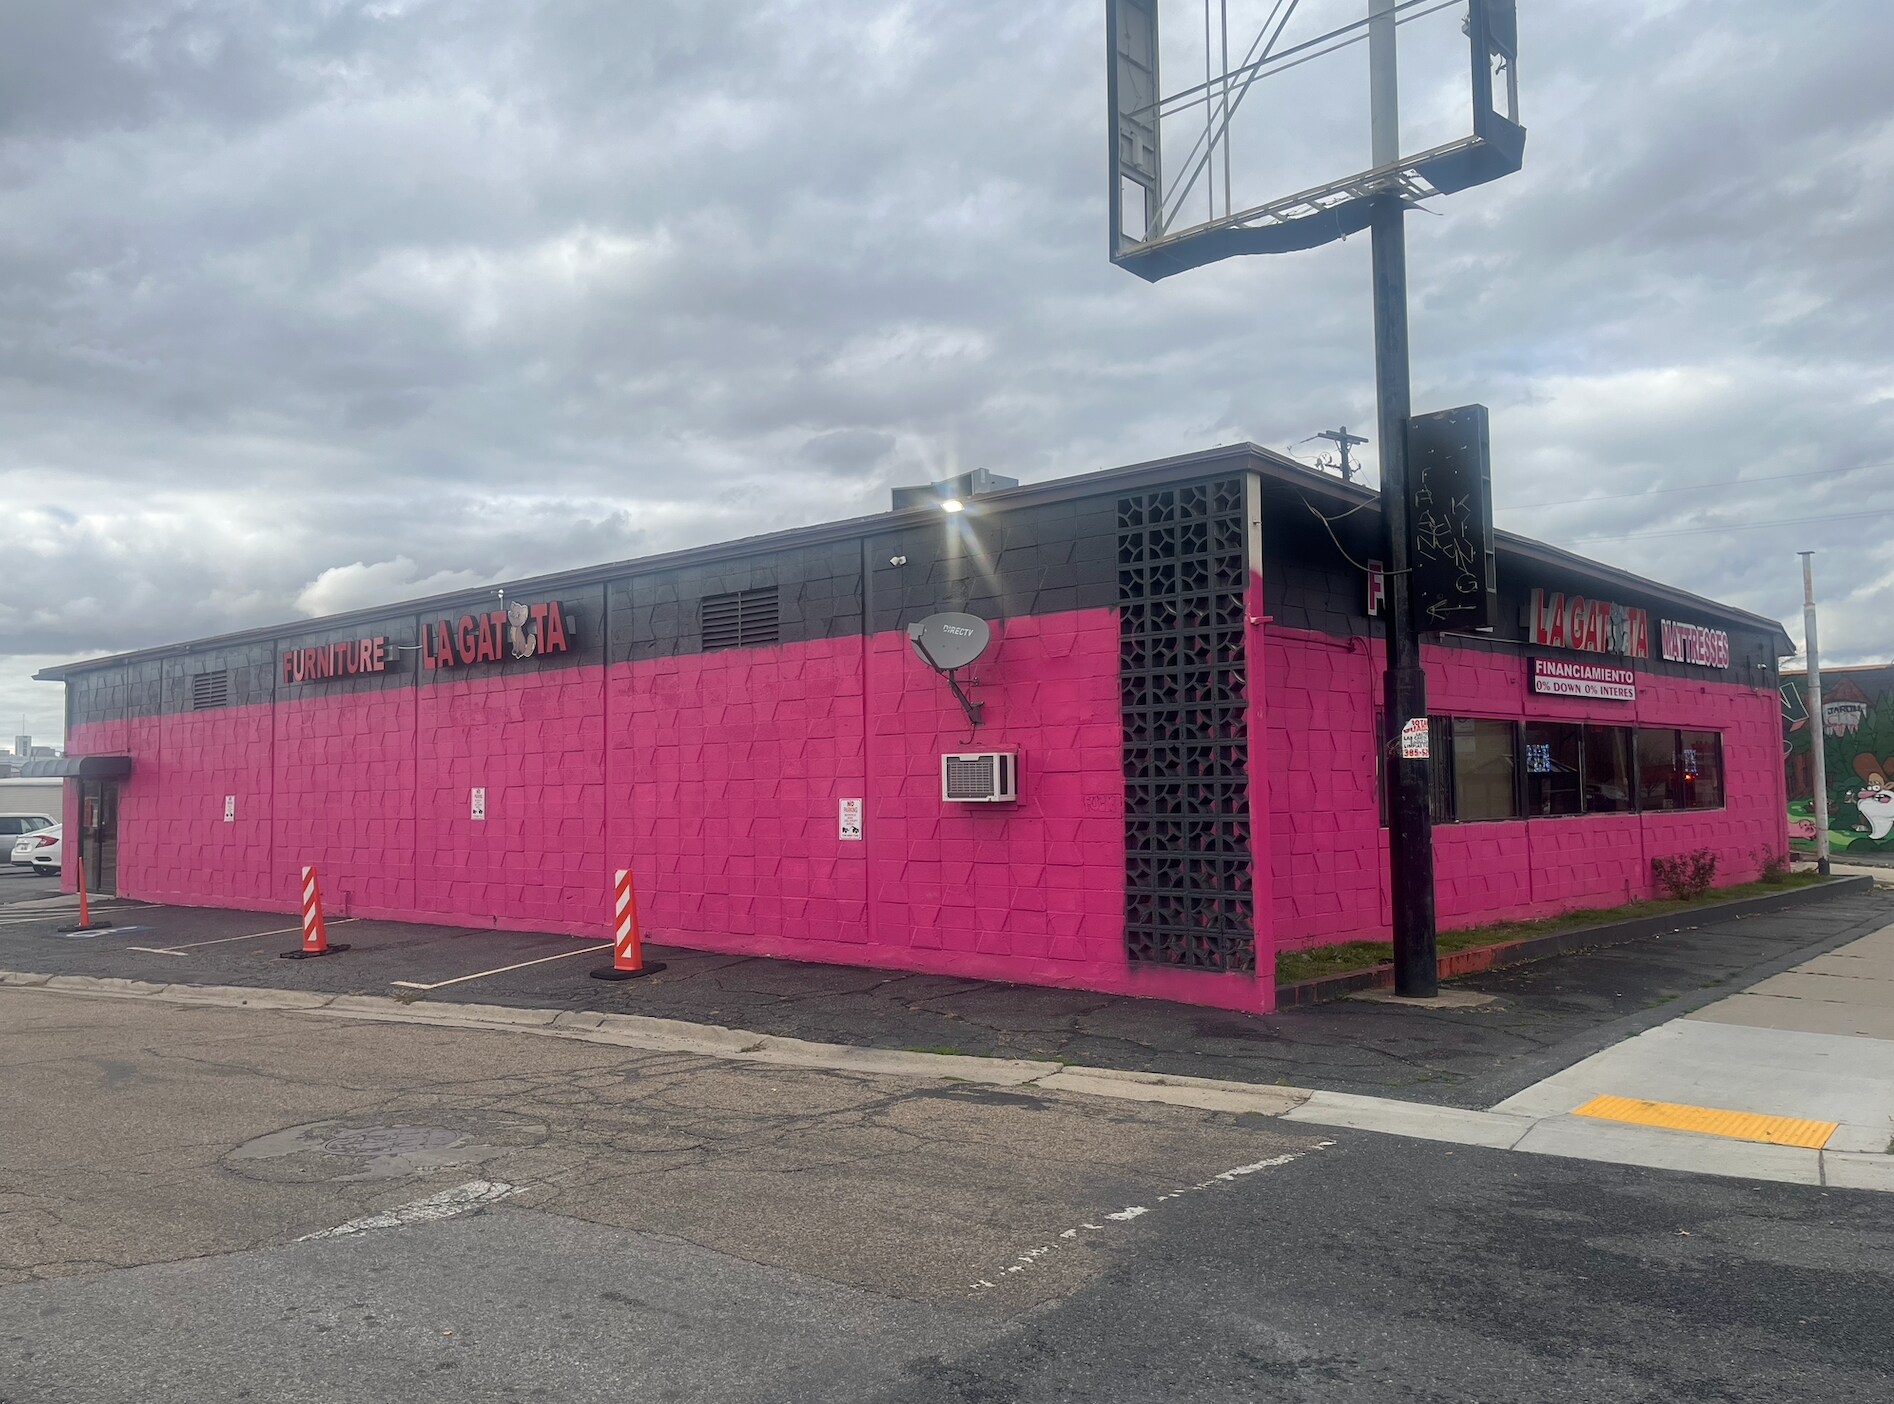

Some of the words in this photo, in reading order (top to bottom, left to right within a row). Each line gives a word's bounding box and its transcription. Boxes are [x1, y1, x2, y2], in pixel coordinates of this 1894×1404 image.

[942, 624, 975, 637] DIRECTV
[1532, 587, 1566, 648] LA
[283, 636, 386, 683] FURNITURE
[422, 620, 454, 670] LA
[1660, 618, 1731, 670] MATTRESSES
[1535, 659, 1634, 684] FINANCIAMIENTO
[1536, 679, 1551, 692] 0%
[1553, 681, 1582, 694] DOWN
[1584, 684, 1598, 695] 0%
[1600, 685, 1634, 698] INTERES
